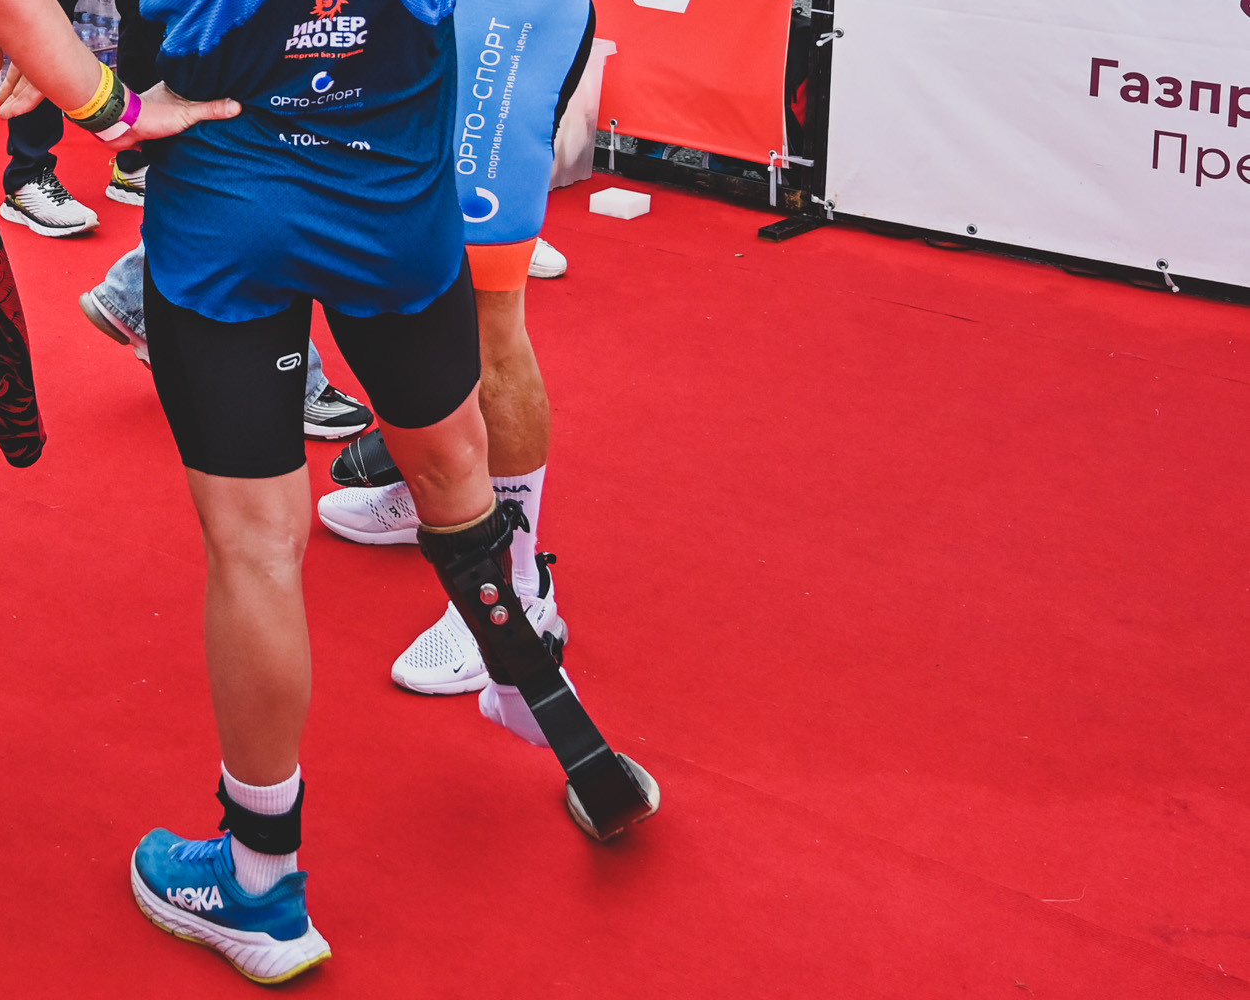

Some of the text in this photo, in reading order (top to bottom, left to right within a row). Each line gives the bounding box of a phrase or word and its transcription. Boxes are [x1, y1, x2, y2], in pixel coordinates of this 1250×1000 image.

[293, 16, 366, 37] ИНТЕР
[285, 30, 368, 51] РАО ЕЭС
[270, 88, 363, 107] ОРТО-СПОРТ
[456, 17, 511, 175] ОРТО-СПОРТ
[487, 22, 533, 179] спортивно-адаптивный центр
[166, 885, 224, 911] HOKA
